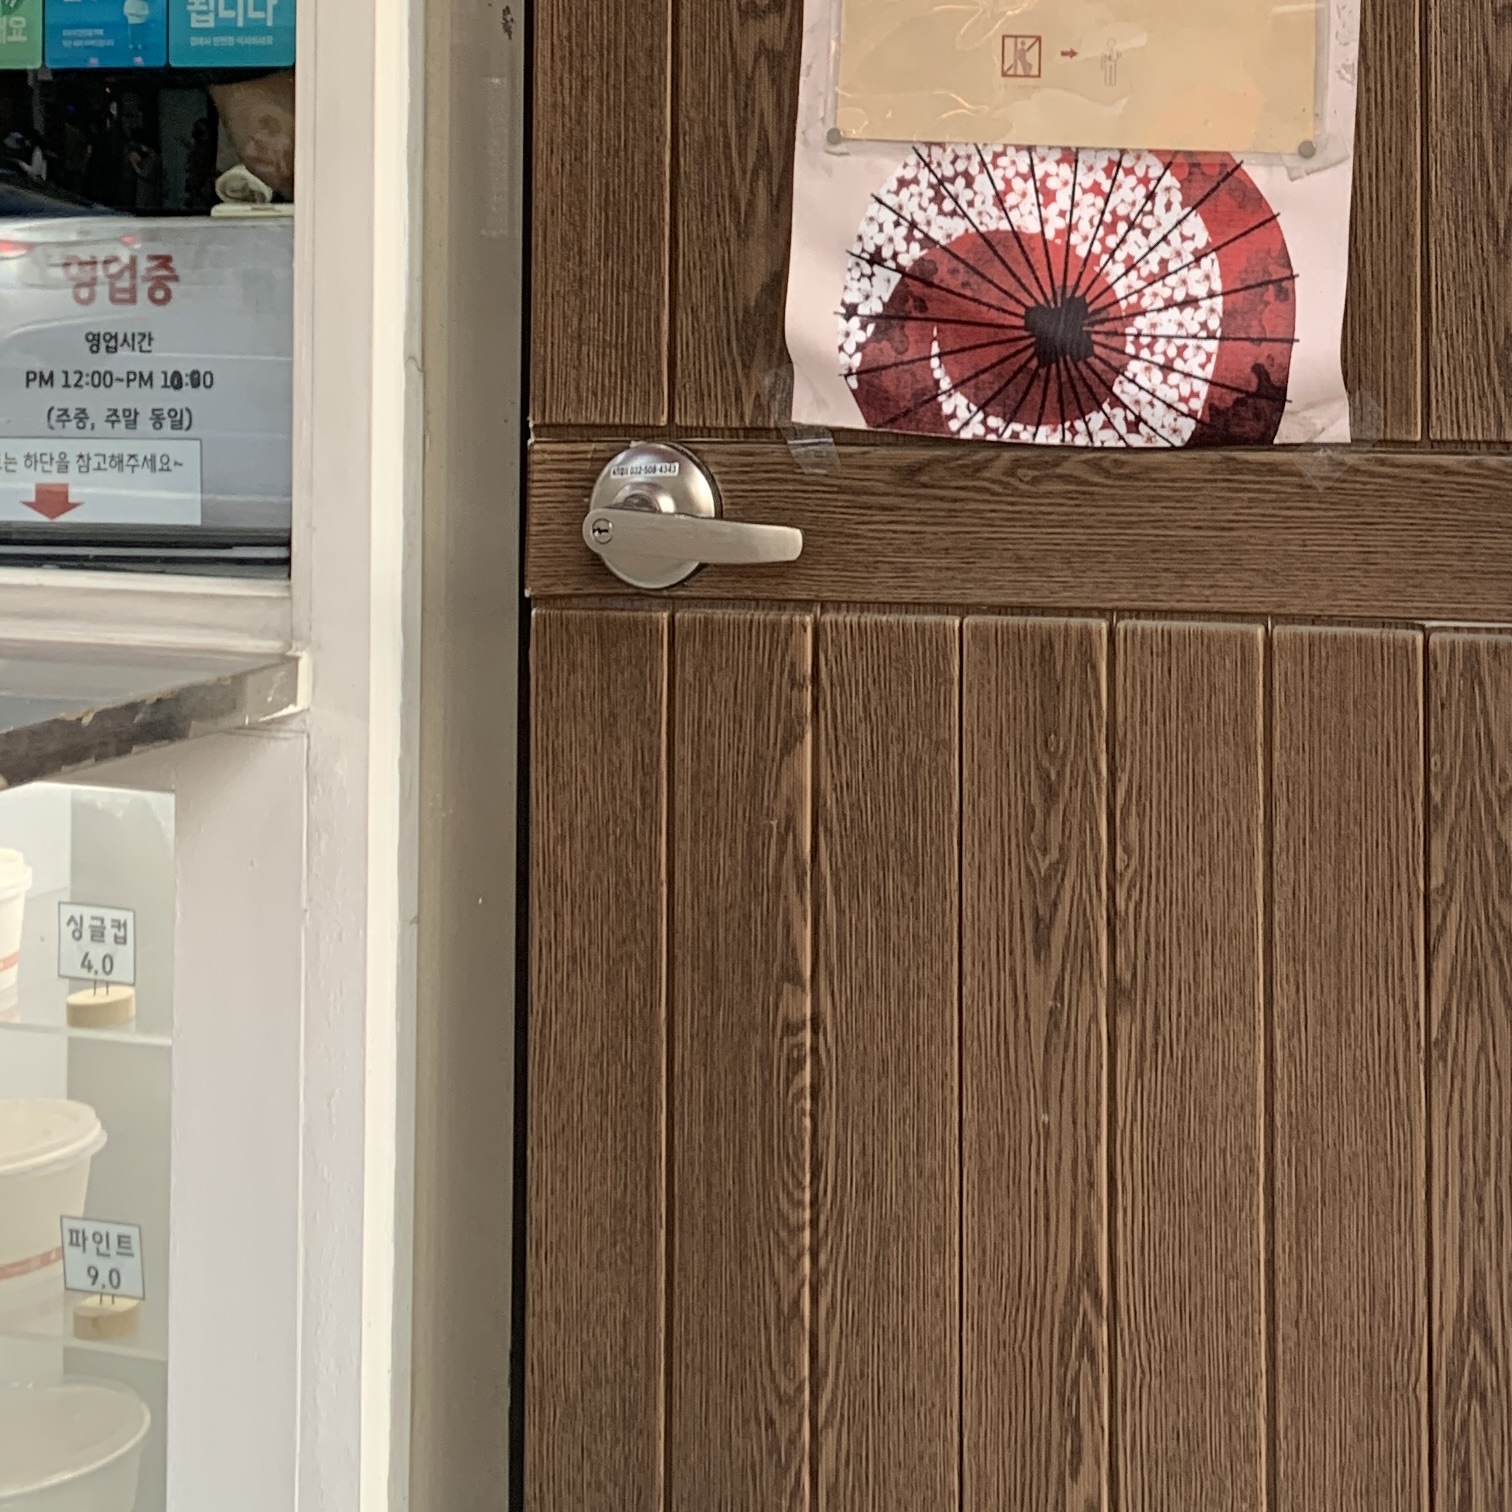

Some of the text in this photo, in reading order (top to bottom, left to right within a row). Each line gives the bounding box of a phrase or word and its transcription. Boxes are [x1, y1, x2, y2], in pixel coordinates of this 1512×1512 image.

[62, 254, 180, 306] 영업중
[85, 332, 154, 354] 영업시간
[25, 370, 54, 388] PM
[47, 406, 193, 431] (주중, 주말 동일)
[0, 451, 183, 474] 는 하단을 참고해주세요~
[66, 913, 128, 946] 싱글컵
[80, 951, 115, 976] 4.0
[68, 1228, 135, 1258] 파인트
[87, 1265, 121, 1289] 9.0
